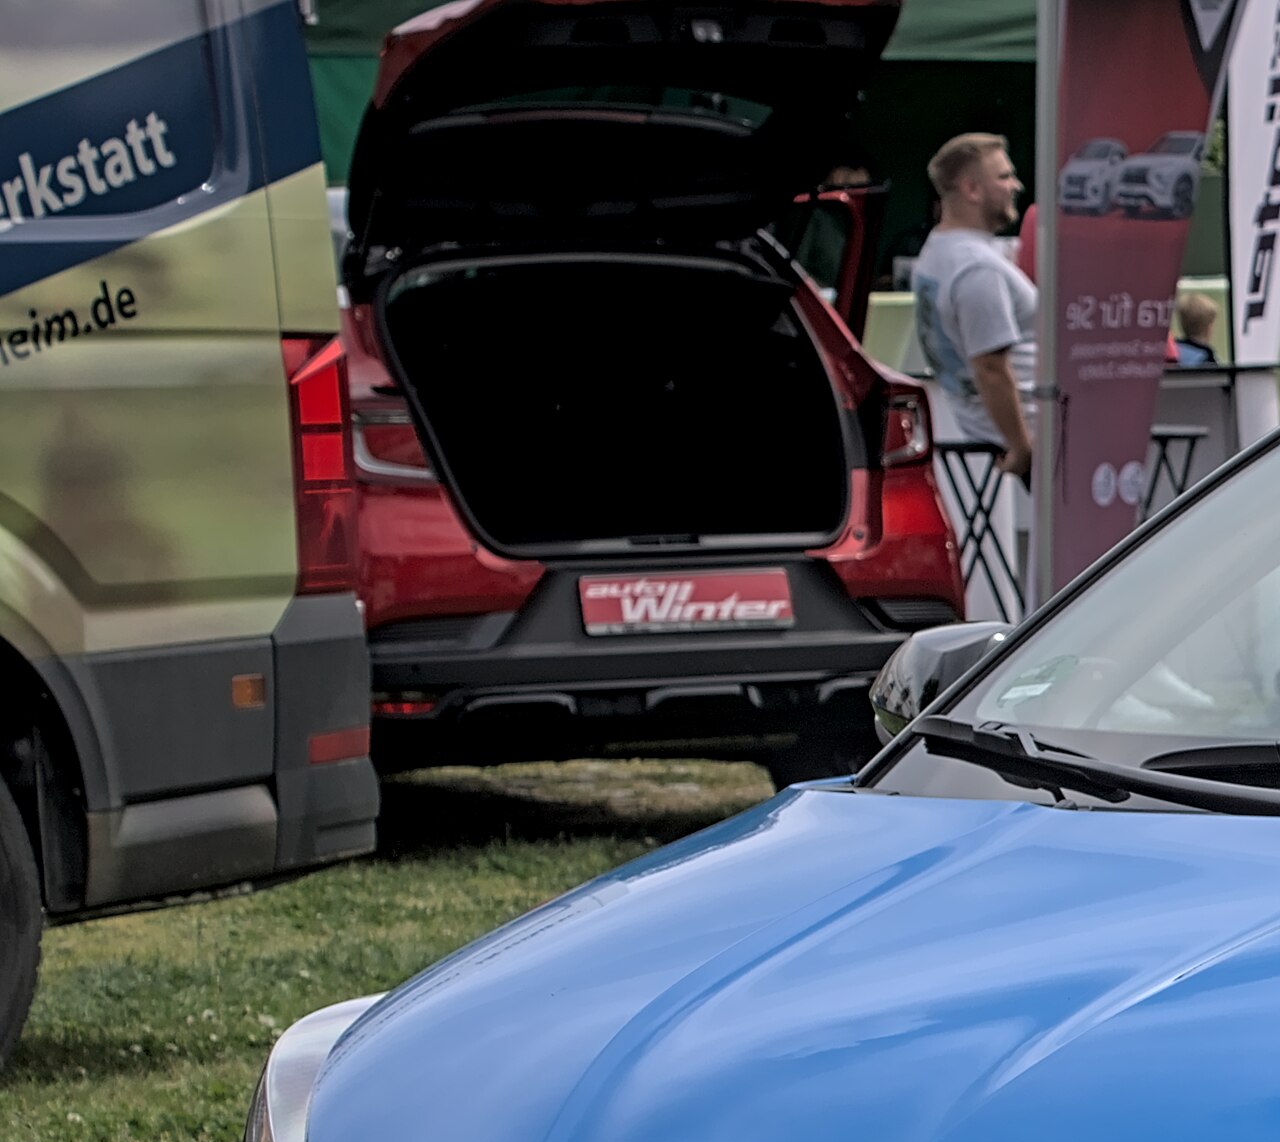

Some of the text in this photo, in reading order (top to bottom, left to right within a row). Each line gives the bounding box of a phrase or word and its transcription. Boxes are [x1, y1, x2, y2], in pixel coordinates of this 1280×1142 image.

[0, 111, 176, 224] rkstatt
[0, 280, 137, 365] eim.de
[585, 578, 665, 599] auto
[620, 580, 788, 623] Winter
